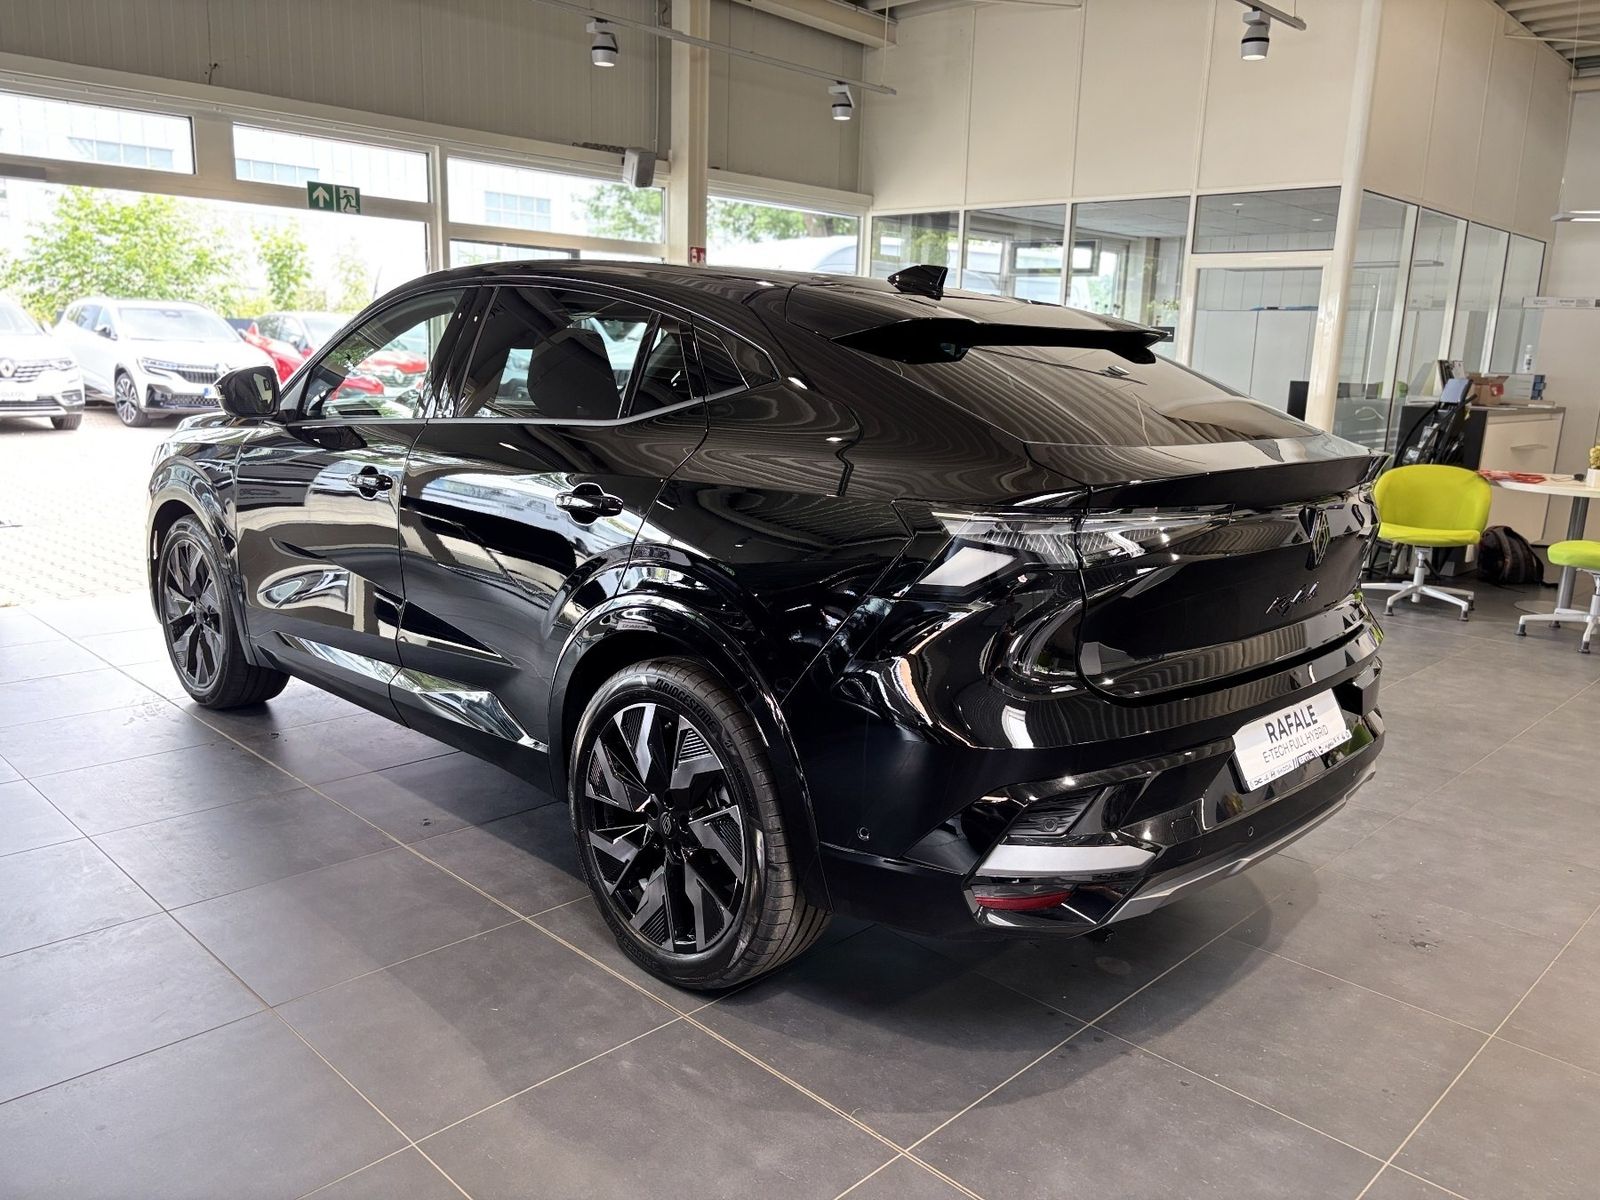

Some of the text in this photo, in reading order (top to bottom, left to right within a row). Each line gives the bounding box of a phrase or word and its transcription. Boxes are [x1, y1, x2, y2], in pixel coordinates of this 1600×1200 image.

[655, 679, 718, 731] BRIDGESTONE
[1265, 704, 1318, 744] RAFALE
[1262, 742, 1289, 763] E-TECH
[1289, 735, 1306, 752] FULL
[1306, 724, 1329, 745] HYBRID
